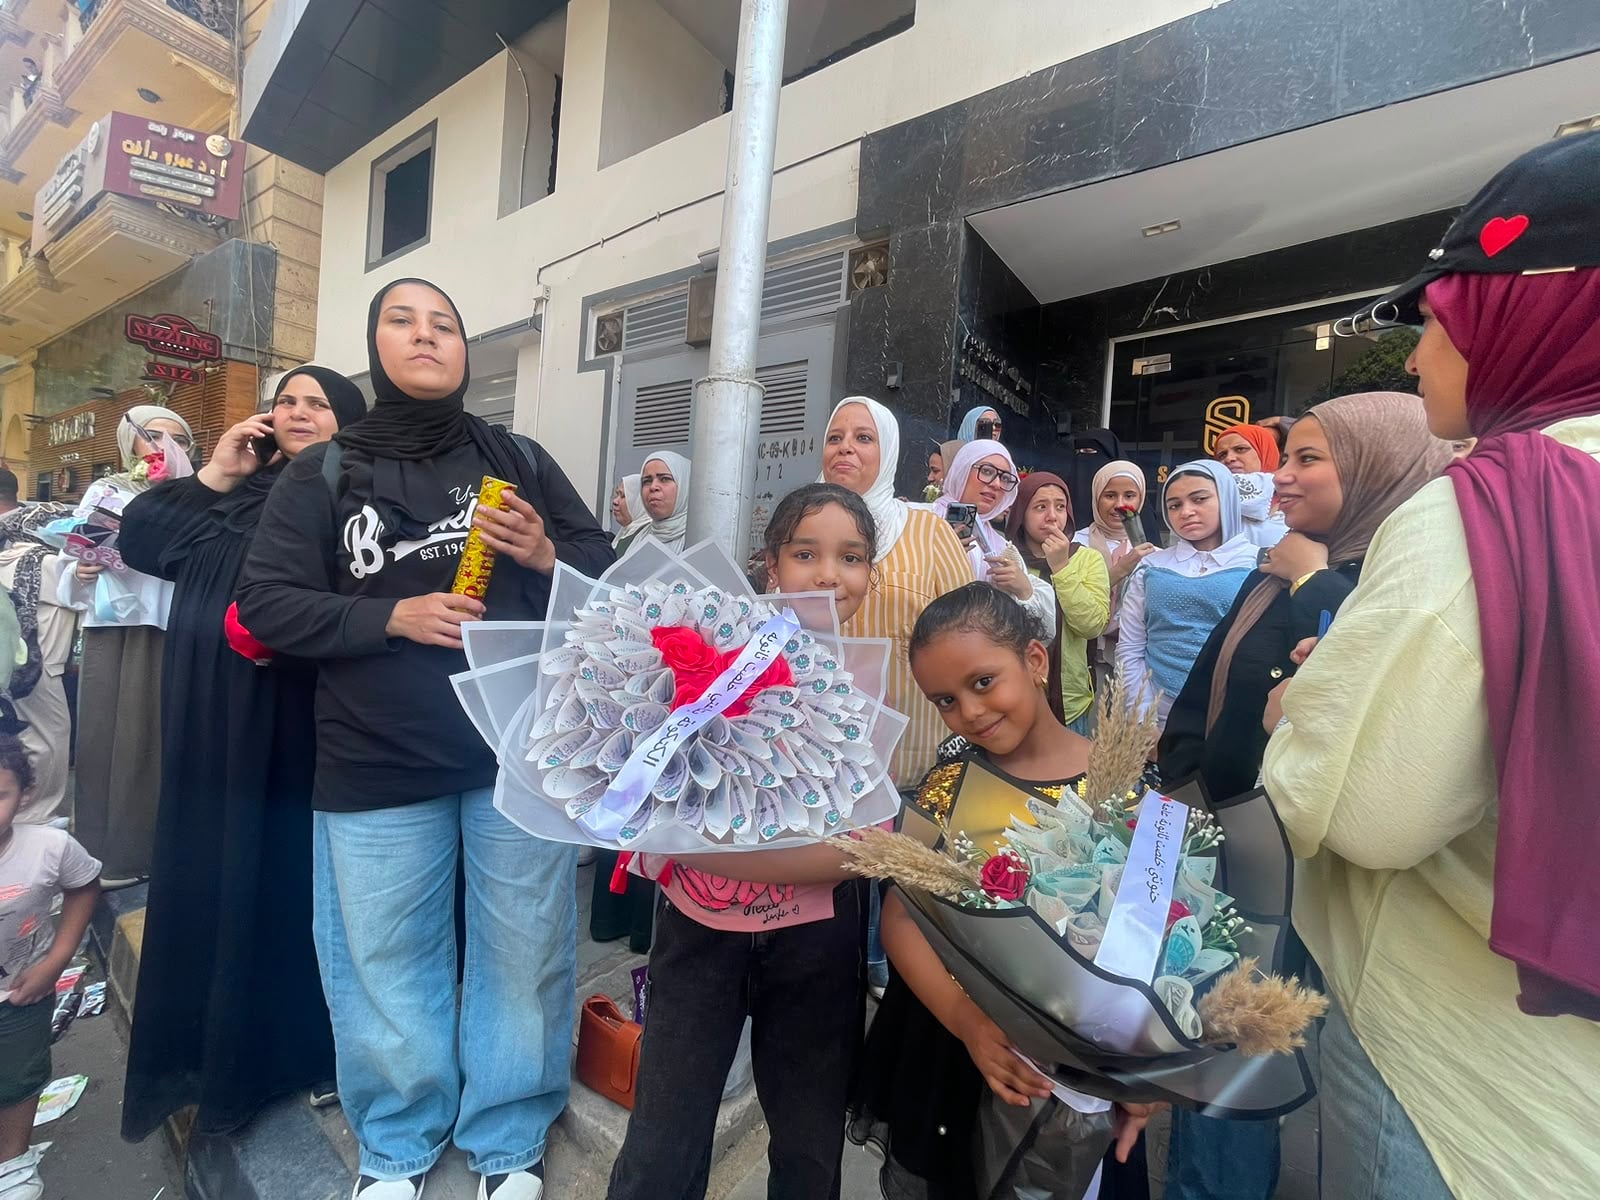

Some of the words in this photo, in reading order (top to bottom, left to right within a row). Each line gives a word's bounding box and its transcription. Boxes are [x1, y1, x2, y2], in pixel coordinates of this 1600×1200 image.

[133, 321, 213, 351] SIZZLING
[153, 364, 194, 381] SIZ
[68, 543, 125, 571] 2026
[463, 550, 496, 601] Part
[726, 662, 756, 693] خلصت
[1154, 843, 1167, 868] خلصت
